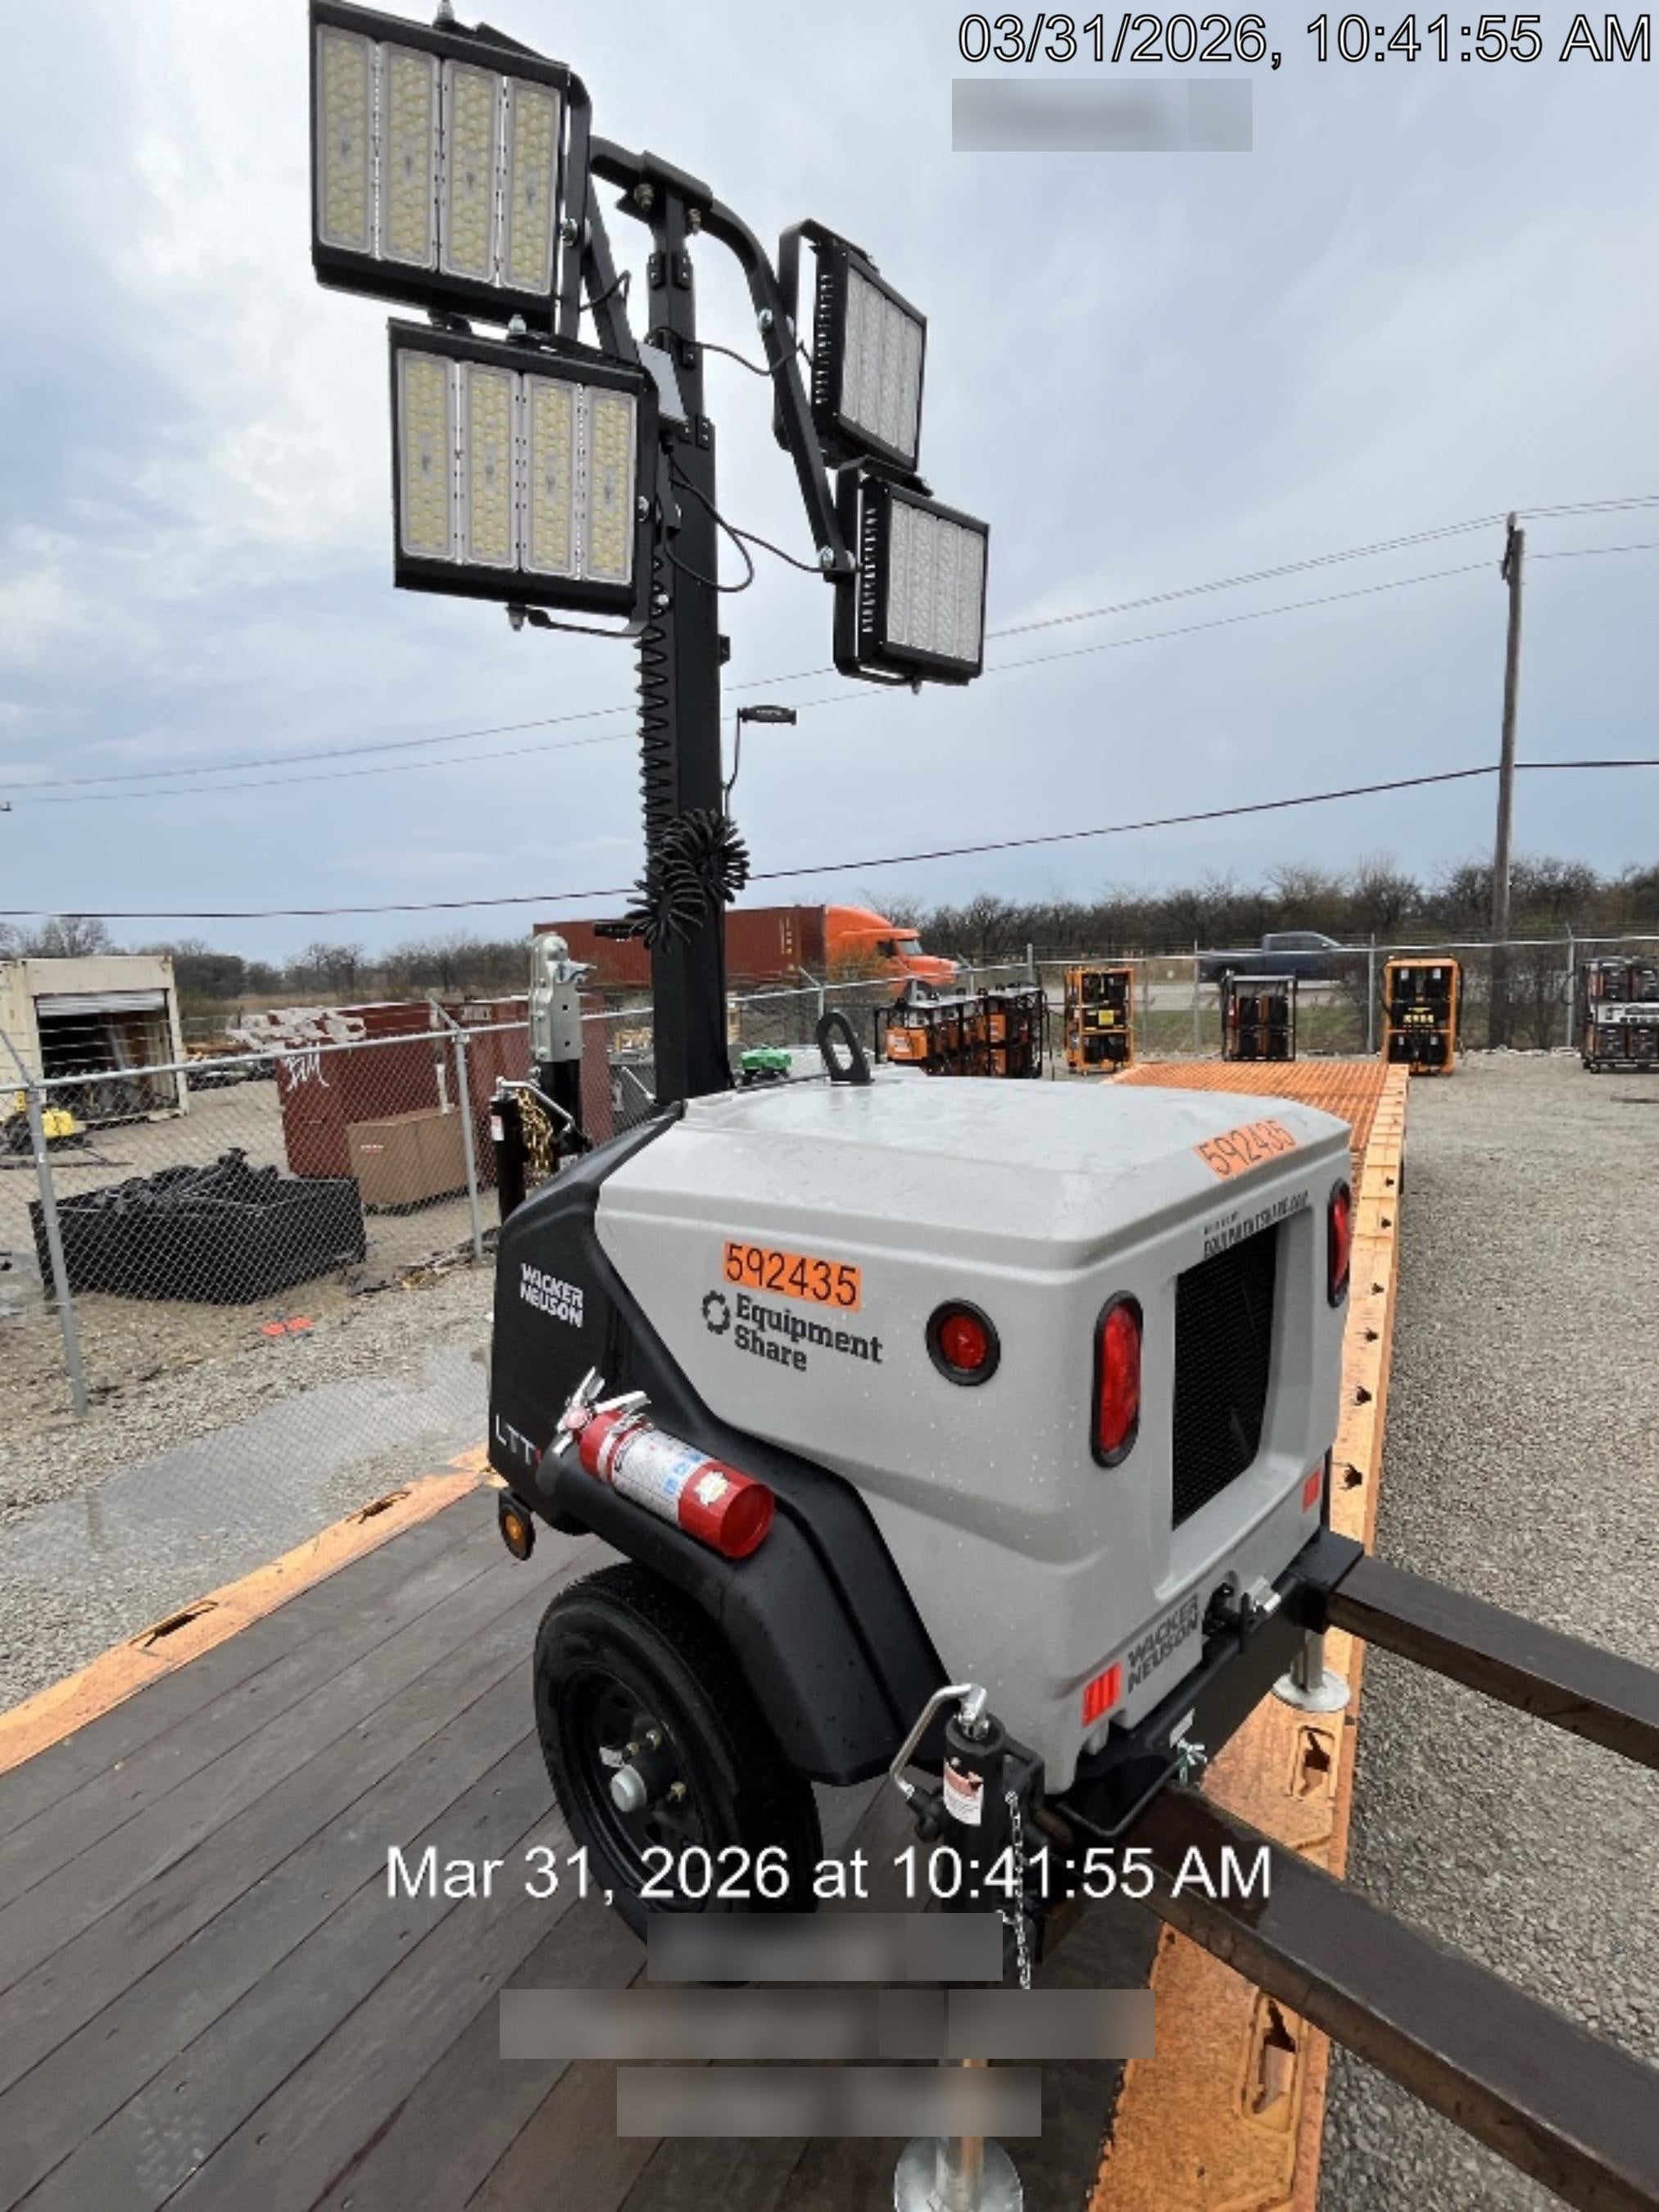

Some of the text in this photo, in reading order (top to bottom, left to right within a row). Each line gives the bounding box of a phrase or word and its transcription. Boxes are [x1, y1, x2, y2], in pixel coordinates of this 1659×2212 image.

[1199, 1119, 1296, 1175] 592435
[520, 1262, 583, 1308] WACKER
[726, 1243, 857, 1306] 592435
[520, 1282, 583, 1328] NEUSON
[736, 1292, 883, 1364] Equipment
[734, 1323, 808, 1372] Share
[1127, 1592, 1198, 1667] WACKER
[1127, 1611, 1198, 1694] NEUSON
